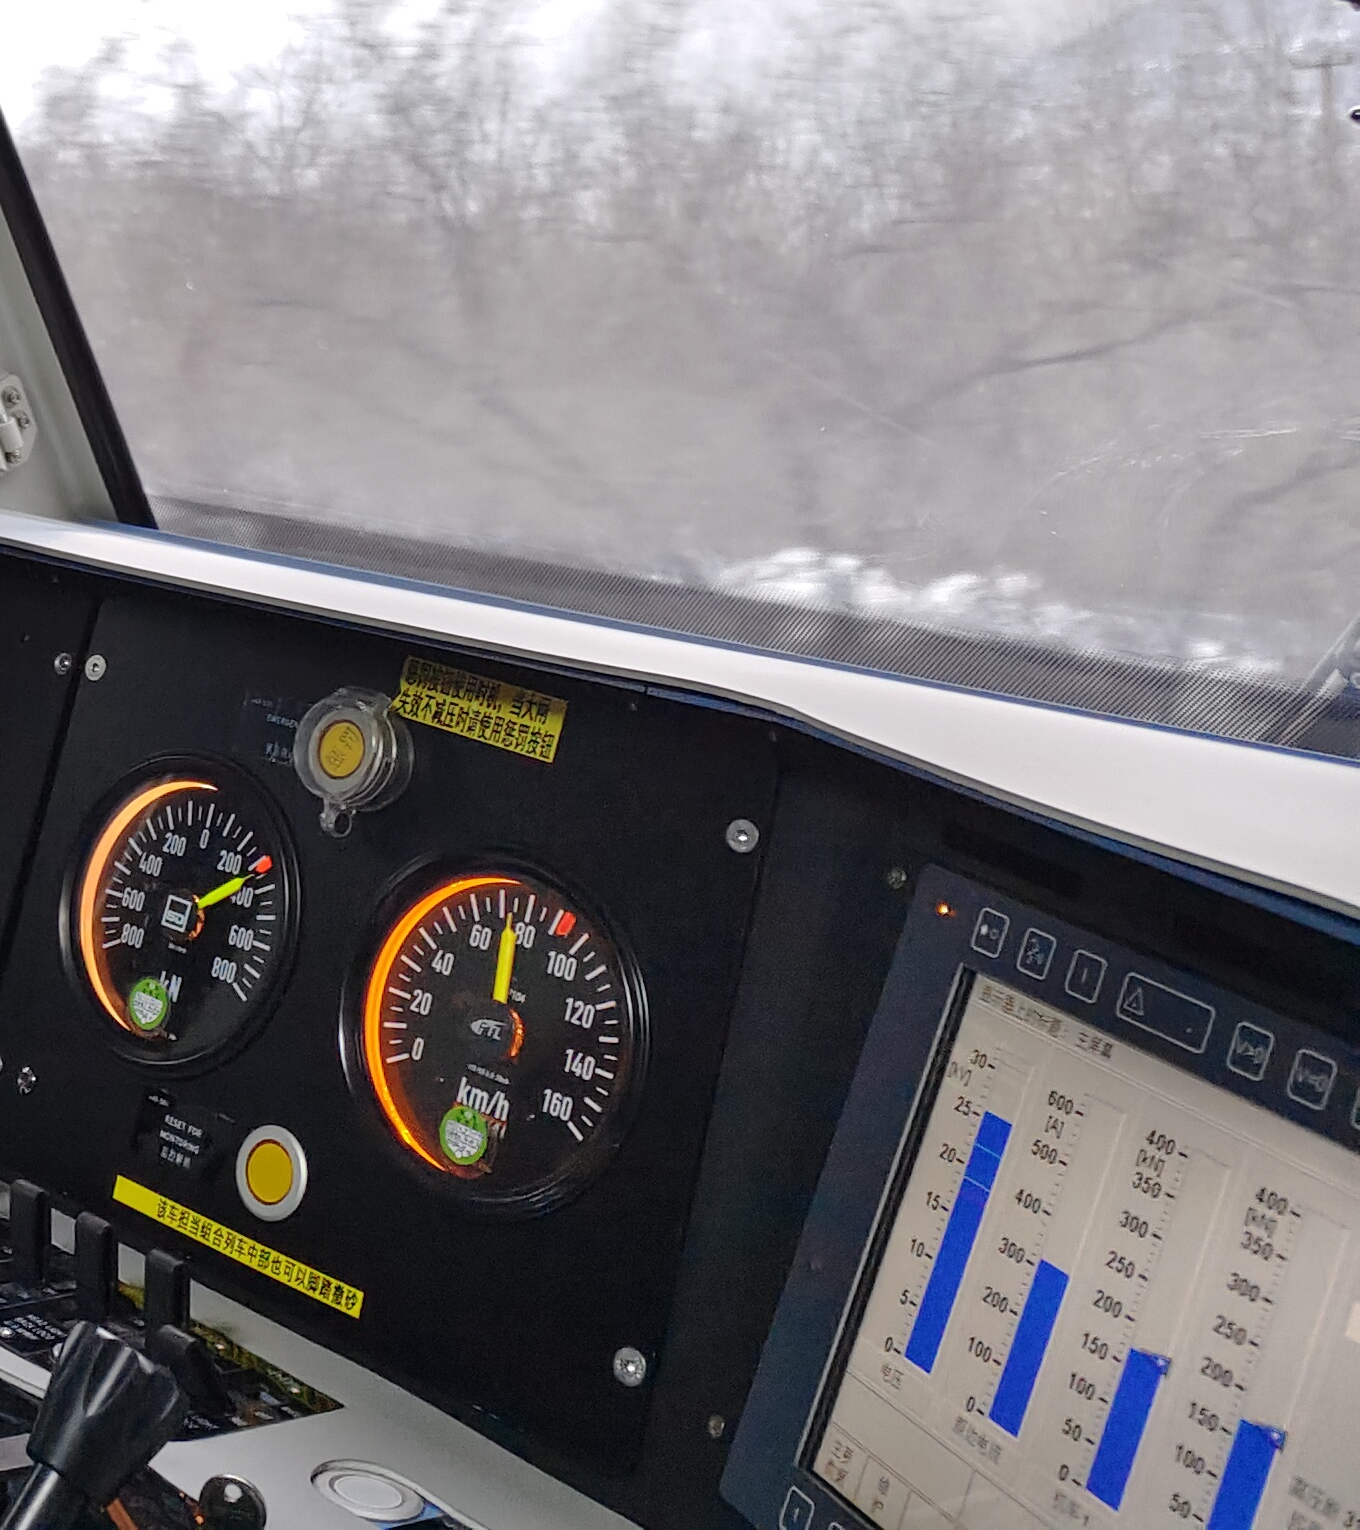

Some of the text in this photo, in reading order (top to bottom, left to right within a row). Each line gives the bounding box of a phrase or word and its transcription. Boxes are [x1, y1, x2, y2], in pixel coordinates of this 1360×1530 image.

[163, 832, 187, 857] 200
[199, 828, 210, 849] 0
[139, 852, 163, 877] 400
[217, 849, 242, 875] 200
[121, 886, 145, 911] 600
[120, 923, 144, 949] 800
[228, 924, 254, 951] 600
[469, 924, 492, 951] 60
[211, 956, 237, 984] 800
[431, 949, 455, 976] 40
[546, 950, 578, 981] 100
[410, 989, 432, 1016] 20
[564, 997, 595, 1029] 120
[411, 1037, 425, 1061] 0
[970, 1049, 988, 1069] 30
[564, 1049, 595, 1081] 140
[456, 1076, 510, 1121] km/h
[542, 1088, 574, 1121] 160
[953, 1096, 974, 1116] 25
[1047, 1090, 1074, 1115] 600
[1043, 1114, 1066, 1139] [A]
[939, 1142, 958, 1163] 20
[1031, 1140, 1059, 1165] 500
[1145, 1129, 1176, 1156] 400
[1132, 1172, 1161, 1199] 350
[925, 1190, 943, 1210] 15
[1014, 1188, 1042, 1214] 400
[1255, 1187, 1288, 1216] 400
[1119, 1210, 1148, 1238] 300
[909, 1238, 926, 1257] 10
[998, 1237, 1026, 1264] 300
[1240, 1231, 1274, 1261] 350
[1105, 1250, 1134, 1279] 250
[899, 1288, 910, 1304] 5
[983, 1286, 1009, 1313] 200
[1227, 1272, 1261, 1303] 300
[1093, 1289, 1122, 1320] 200
[1212, 1314, 1248, 1346] 250
[884, 1336, 894, 1353] 0
[967, 1335, 993, 1363] 100
[1080, 1332, 1109, 1361] 150
[1200, 1356, 1234, 1388] 200
[1067, 1372, 1096, 1401] 100
[966, 1394, 976, 1412] 0
[1187, 1401, 1219, 1432] 150
[1061, 1418, 1082, 1443] 50
[1059, 1464, 1069, 1482] 0
[1174, 1444, 1206, 1475] 100
[1169, 1492, 1191, 1519] 50
